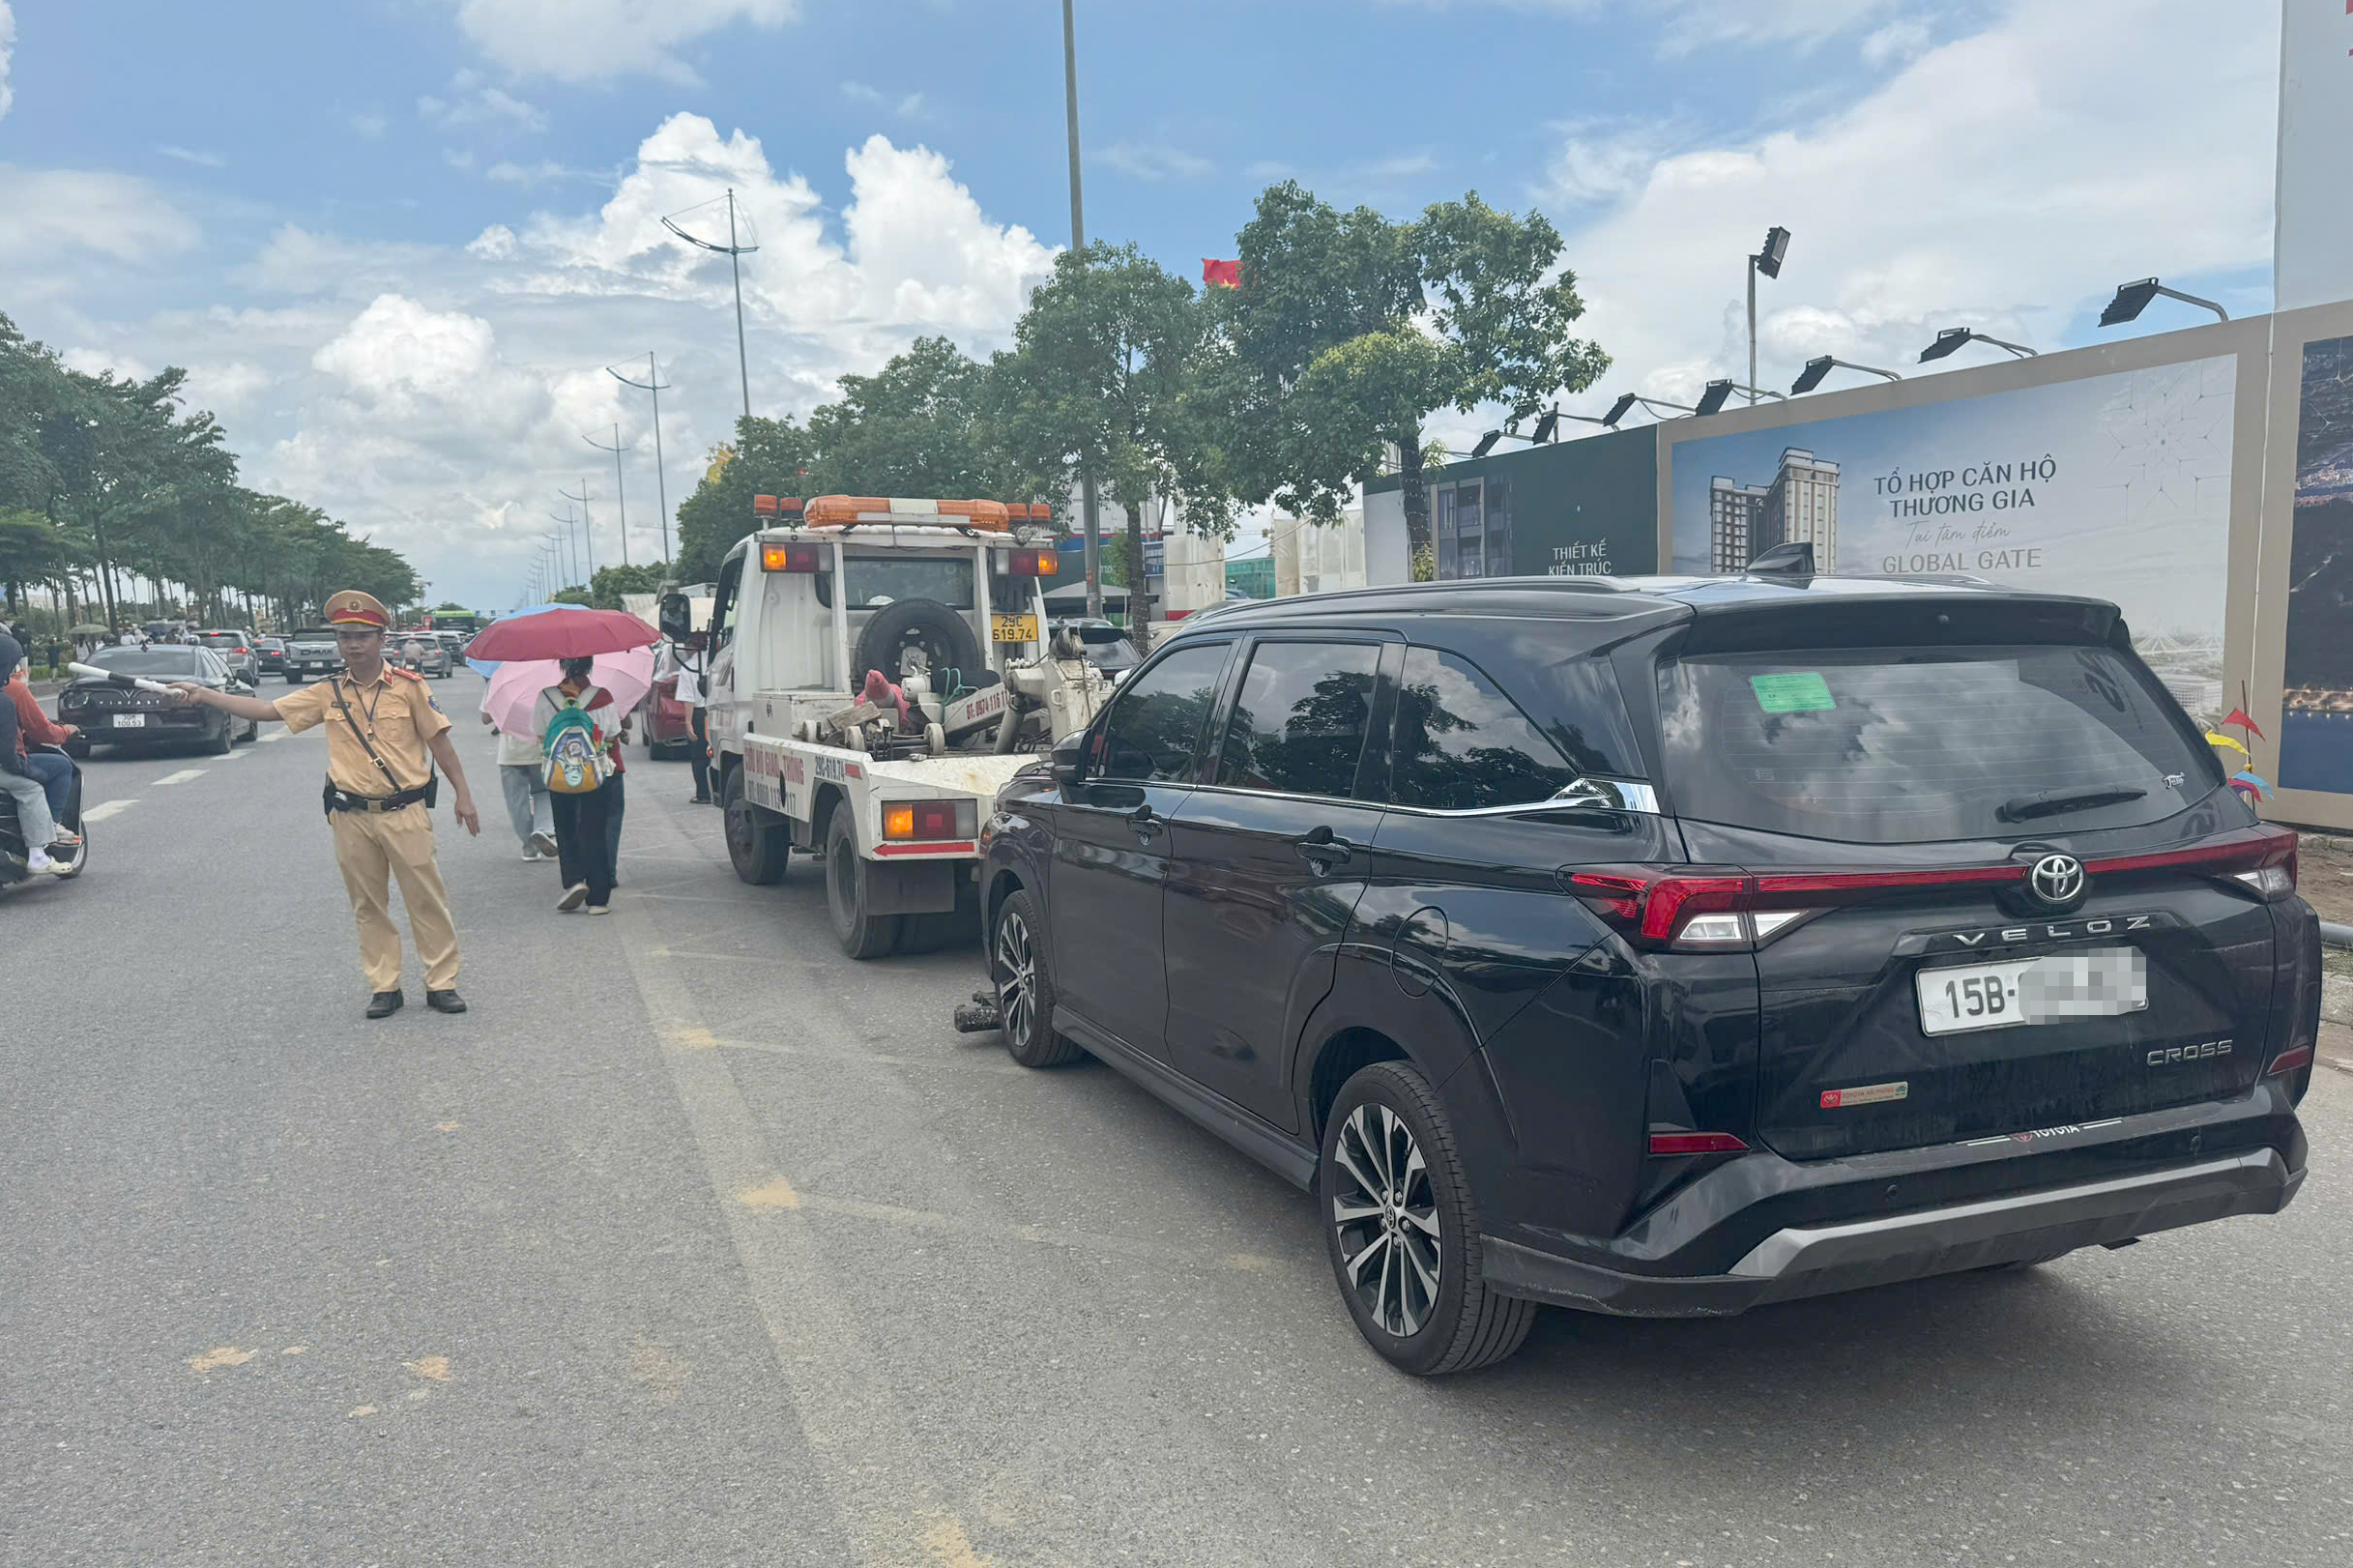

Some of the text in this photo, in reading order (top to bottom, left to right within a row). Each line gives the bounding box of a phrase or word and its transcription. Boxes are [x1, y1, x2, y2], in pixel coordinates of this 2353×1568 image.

[1874, 453, 2056, 495] TỔ HỢP CĂN HỘ
[1890, 488, 2035, 517] THƯƠNG GIA
[1553, 537, 1607, 561] THIẾT KẾ
[1882, 548, 2043, 574] GLOBAL GATE
[1578, 558, 1612, 575] TRÚC
[993, 629, 1032, 640] 619.74
[1002, 616, 1023, 627] 29C
[1953, 915, 2151, 946] VELOZ
[2147, 1039, 2233, 1065] CROSS
